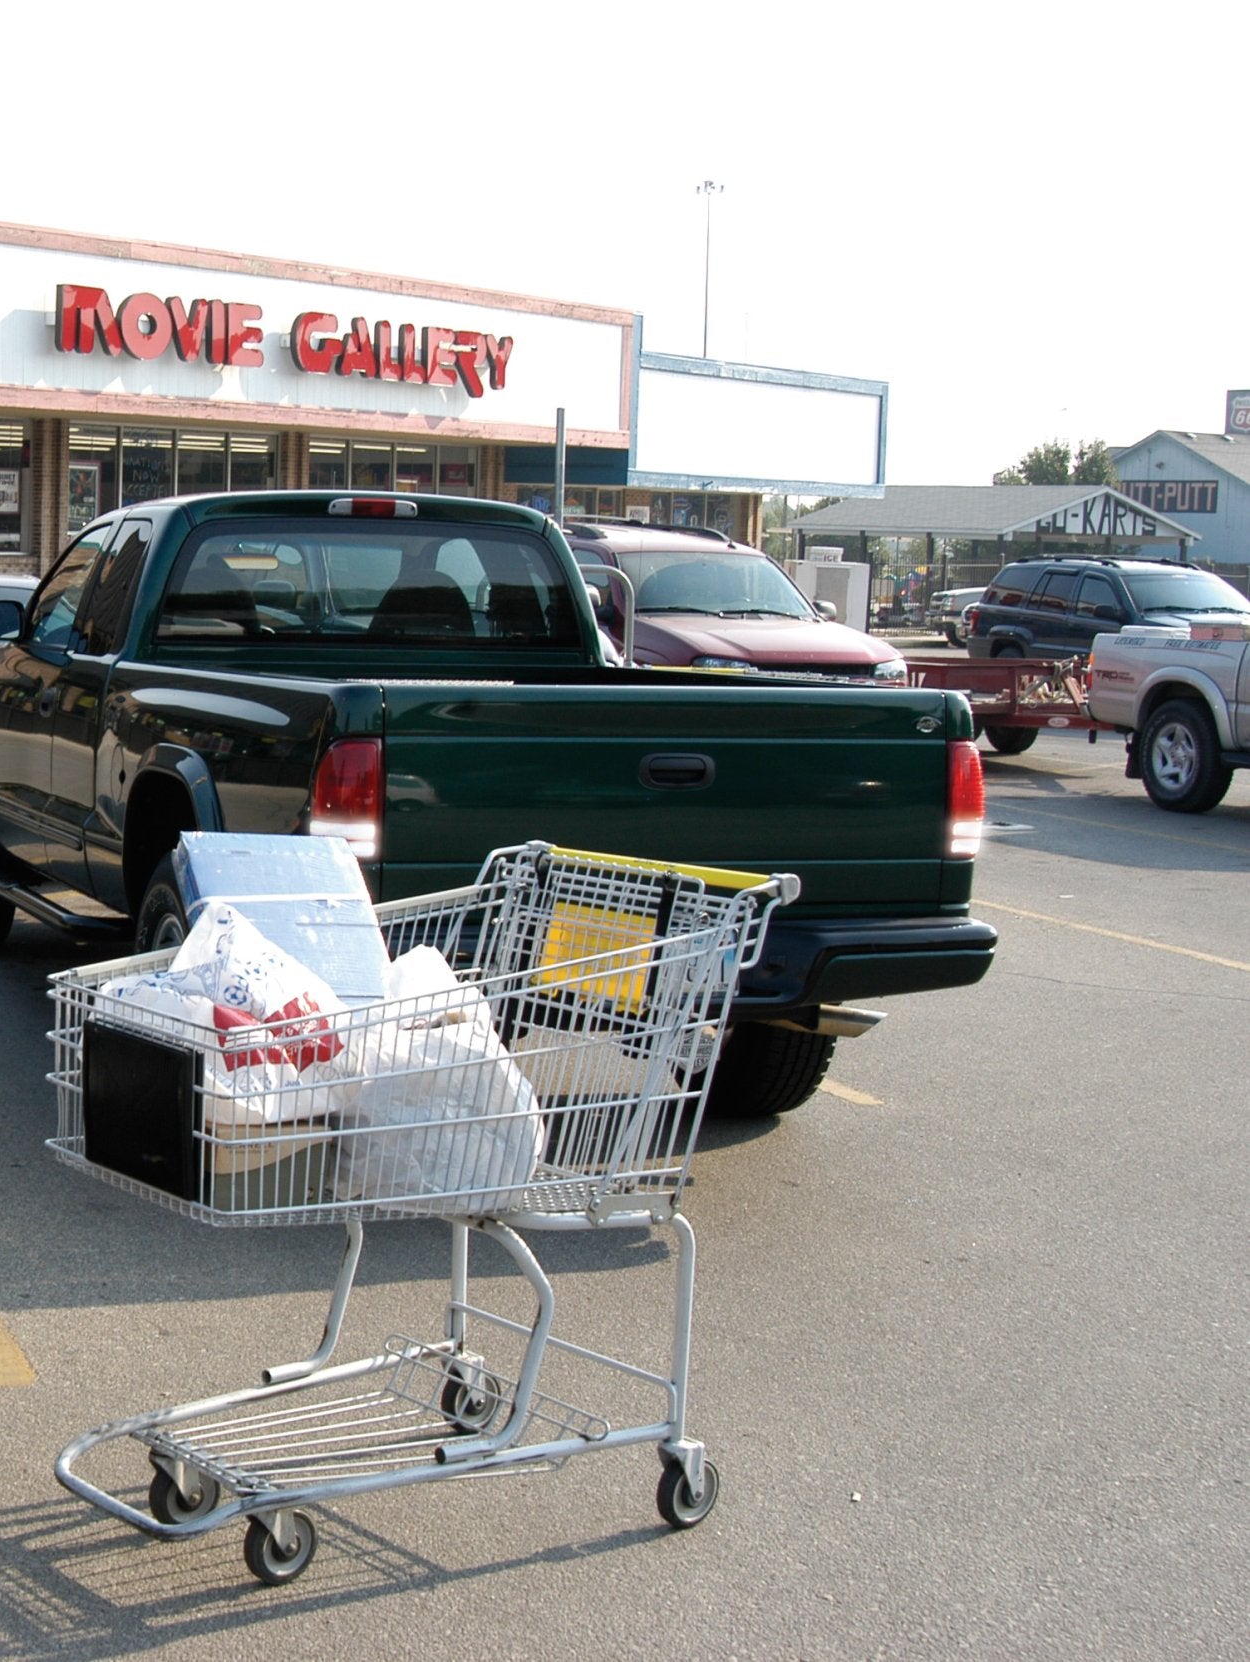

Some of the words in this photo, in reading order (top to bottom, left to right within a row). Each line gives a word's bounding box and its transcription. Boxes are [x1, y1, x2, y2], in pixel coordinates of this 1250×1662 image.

[54, 284, 264, 367] MOVIE
[290, 311, 514, 398] GALLERY
[1118, 482, 1217, 512] UTT-PUTT
[823, 554, 840, 563] ICE
[1094, 669, 1118, 681] TRD
